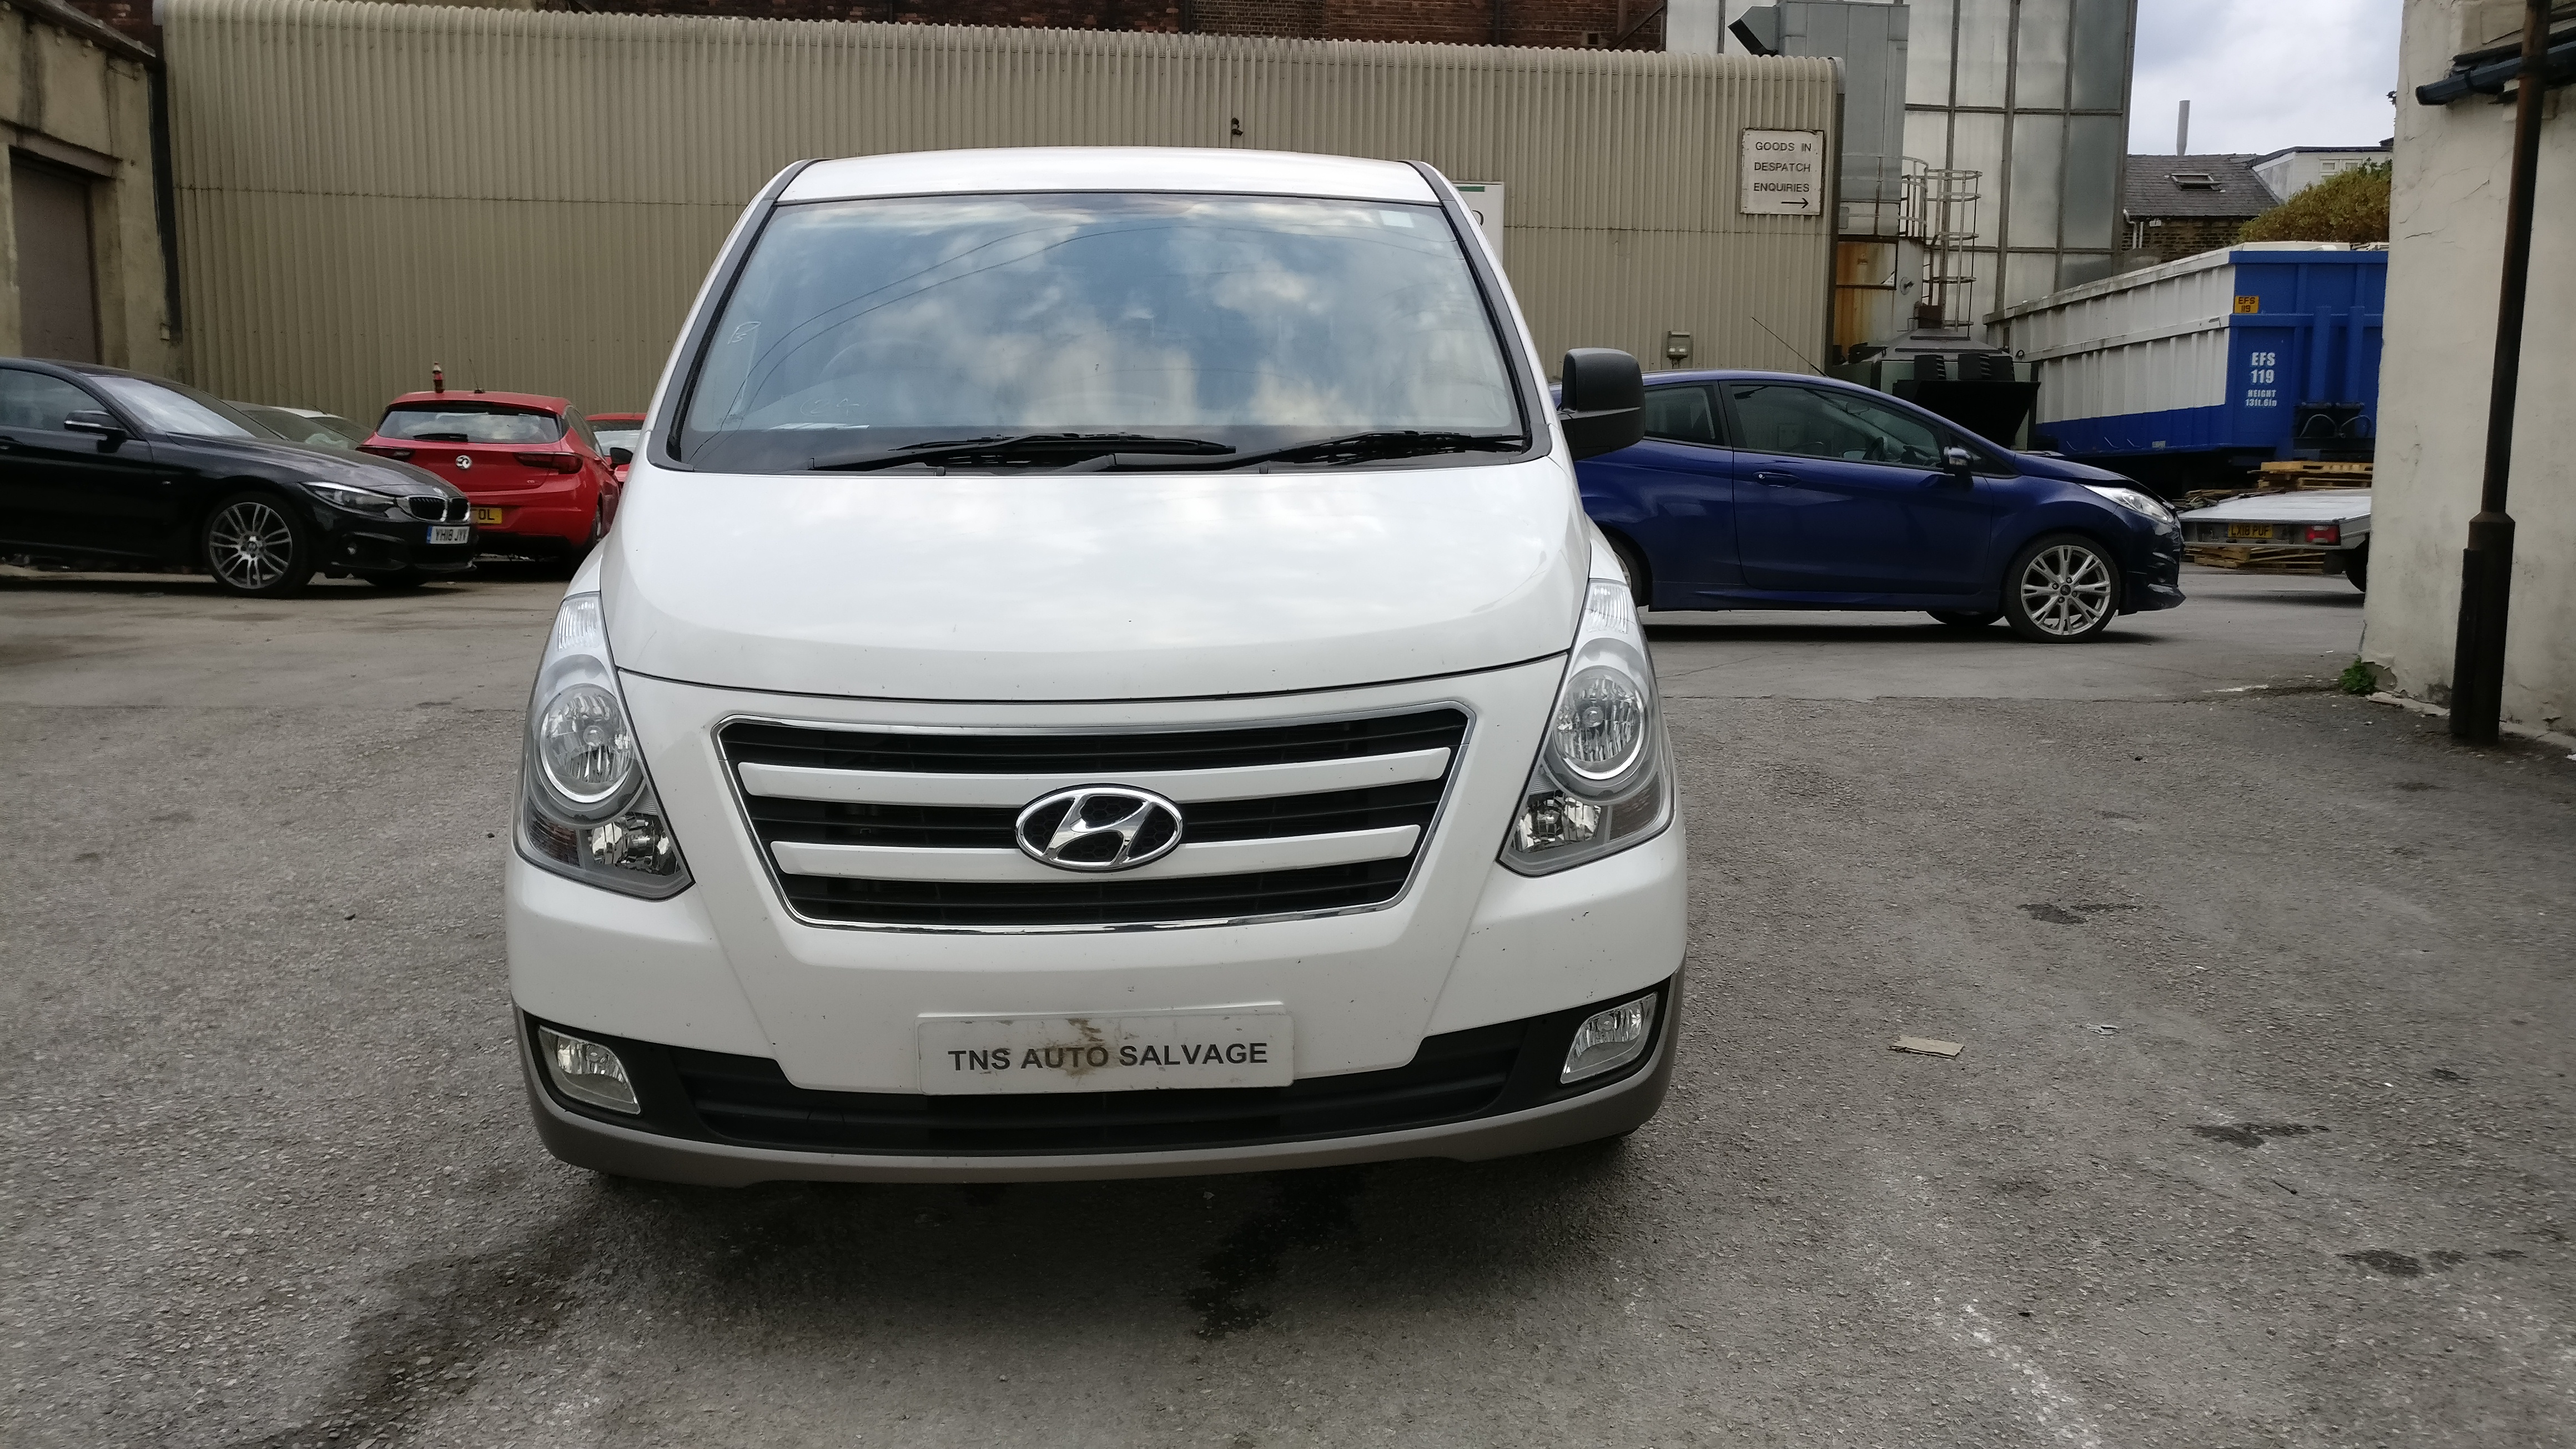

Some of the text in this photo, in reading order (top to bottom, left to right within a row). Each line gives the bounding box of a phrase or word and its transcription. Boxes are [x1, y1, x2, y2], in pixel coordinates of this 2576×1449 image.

[1755, 141, 1812, 152] GOODS IN
[1754, 162, 1811, 173] DESPATCH
[1753, 182, 1810, 193] ENQUIRIES
[2238, 296, 2256, 305] EFS
[2251, 351, 2276, 366] EFS
[2250, 369, 2275, 384] 119
[2247, 389, 2277, 398] HEIGHT
[948, 1042, 1268, 1071] TNS AUTO SALVAGE
